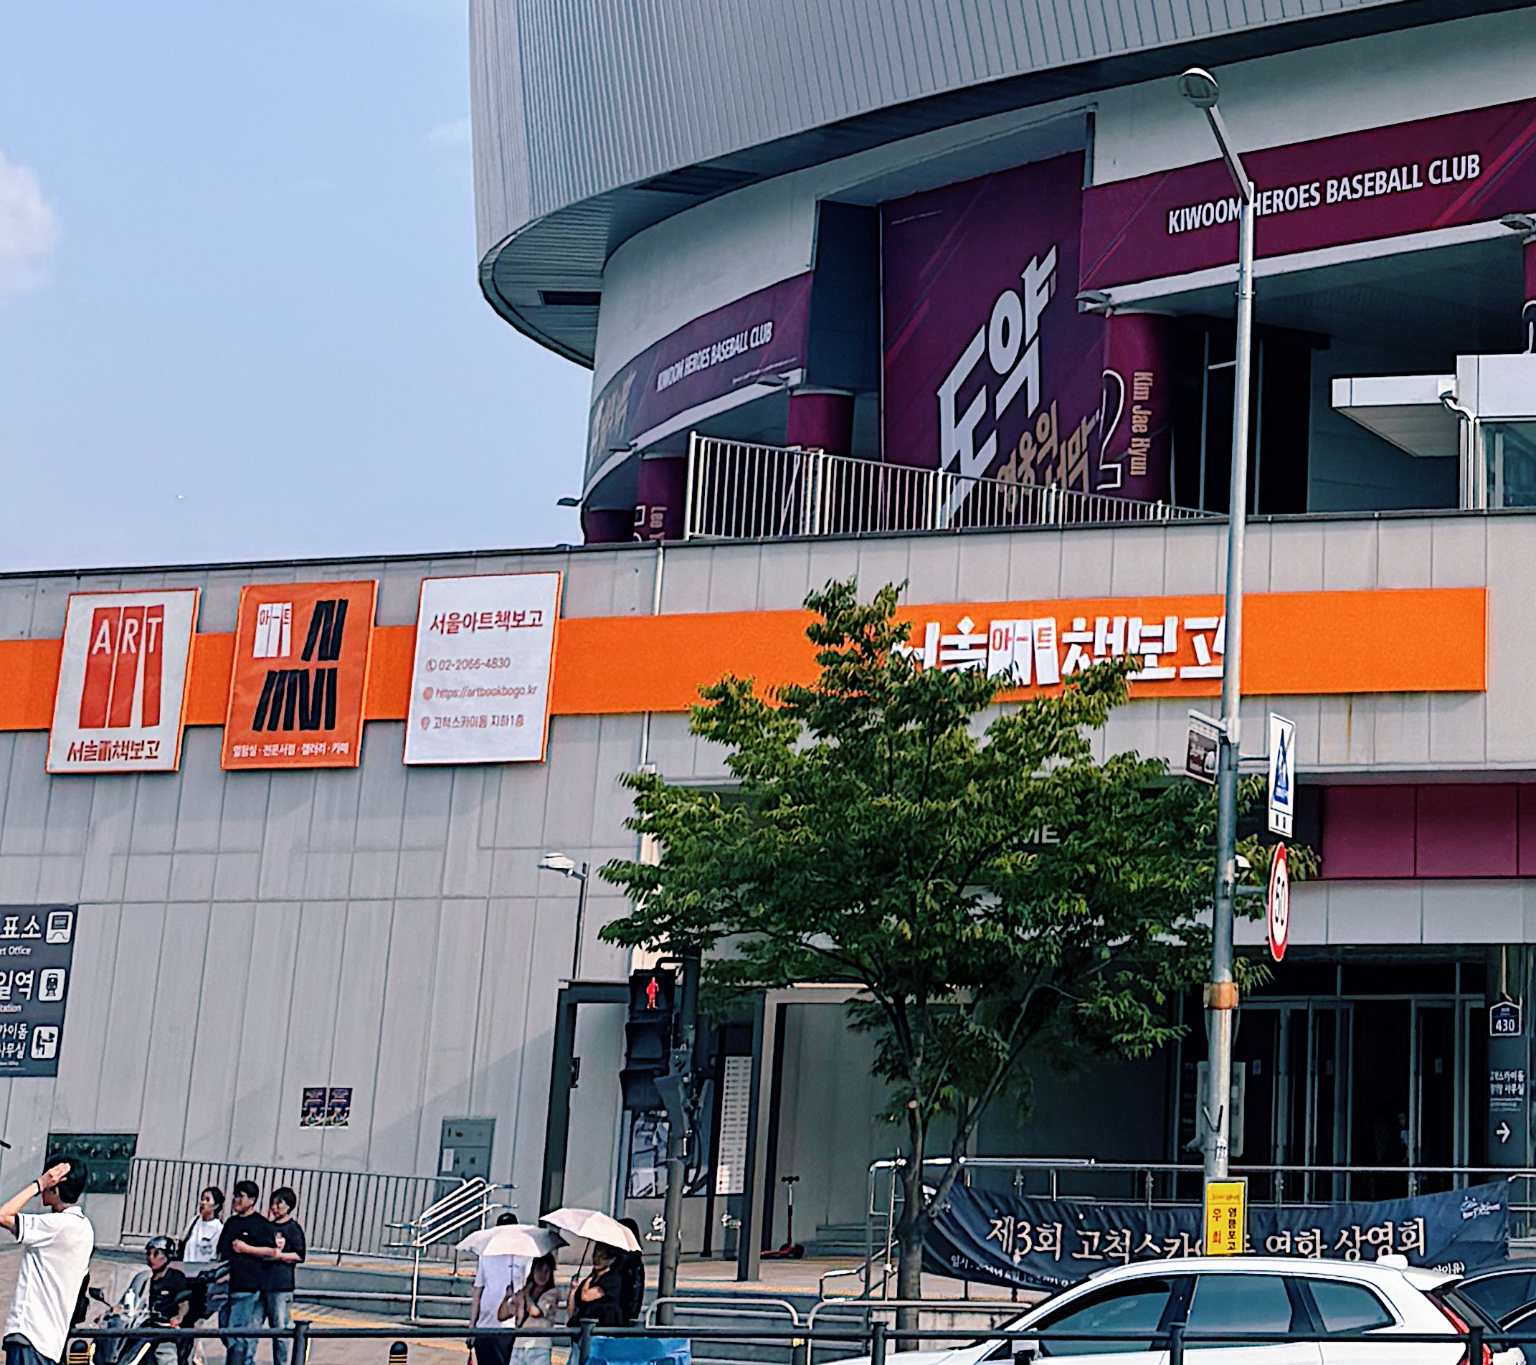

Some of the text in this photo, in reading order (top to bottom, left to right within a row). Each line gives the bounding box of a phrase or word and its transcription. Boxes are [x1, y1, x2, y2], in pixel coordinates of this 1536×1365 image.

[1168, 153, 1481, 235] KIWOOM HEROES BASEBALL CLUB
[656, 361, 684, 392] KIWOOM
[684, 348, 711, 376] HEROES
[711, 331, 749, 365] BASEBALL
[750, 321, 773, 350] CLUB
[1127, 371, 1154, 477] Kim Jae Hyun
[91, 616, 163, 655] ART
[429, 610, 544, 636] 서울아트책보고
[0, 915, 42, 939] 표소
[1495, 1019, 1516, 1032] 430
[985, 1215, 1063, 1262] 제3회
[1334, 1216, 1426, 1261] 상영회
